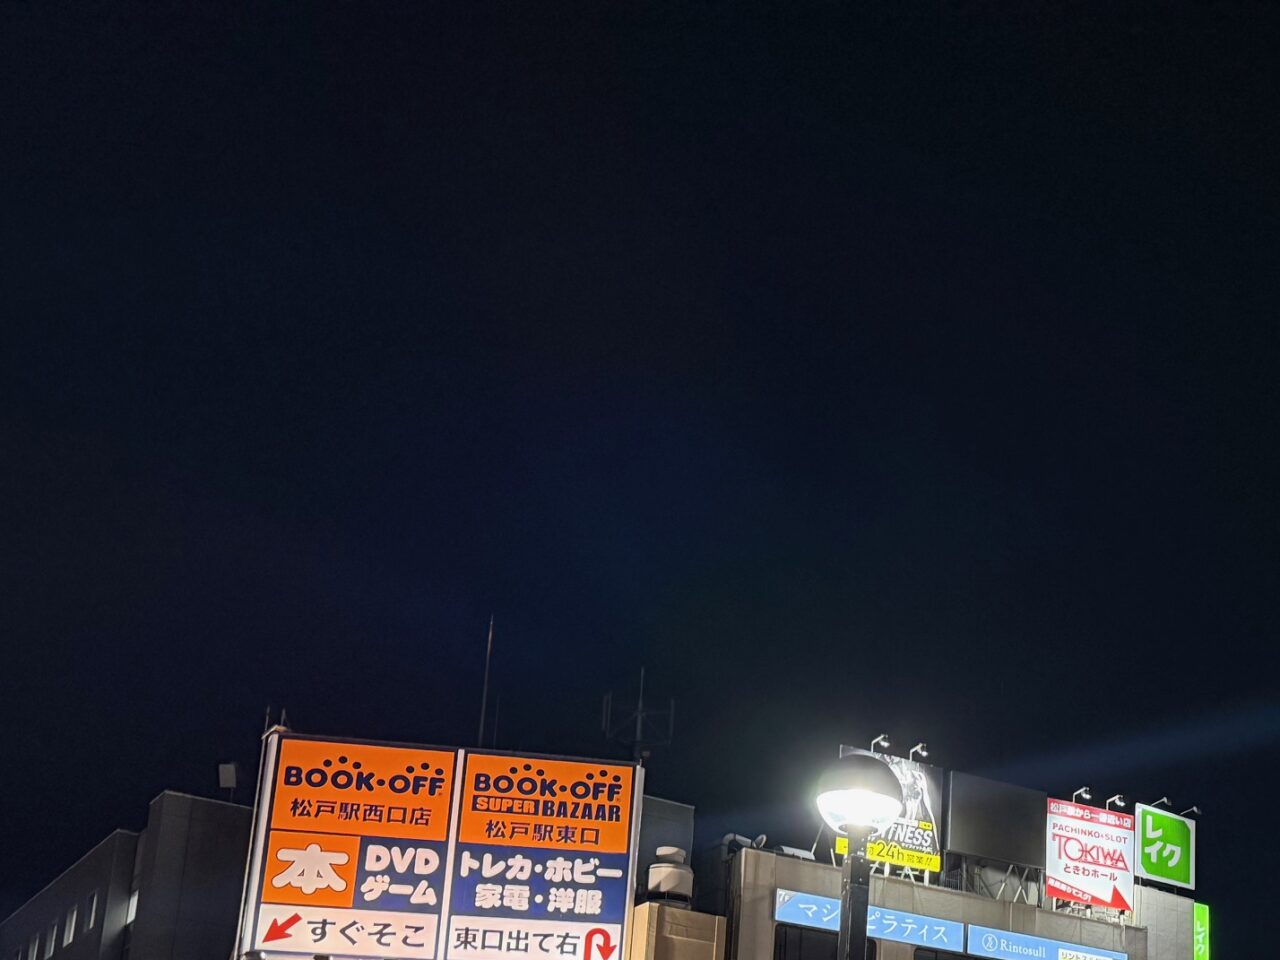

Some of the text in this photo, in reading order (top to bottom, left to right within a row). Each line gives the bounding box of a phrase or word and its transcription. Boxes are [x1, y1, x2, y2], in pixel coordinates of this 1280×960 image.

[290, 797, 433, 827] 松戸駅西口店
[474, 795, 622, 823] SUPER BAZAAR
[485, 819, 601, 846] 松戸駅東口
[364, 843, 441, 876] DVD
[1051, 832, 1130, 873] TOKIWA
[272, 842, 351, 896] 本
[1063, 863, 1118, 882] ときわホール
[360, 875, 438, 907] ゲーム
[306, 917, 426, 948] すぐそこ
[453, 926, 581, 957] 東口出て右
[1195, 920, 1205, 955] レイク
[1000, 938, 1047, 959] Rintosull
